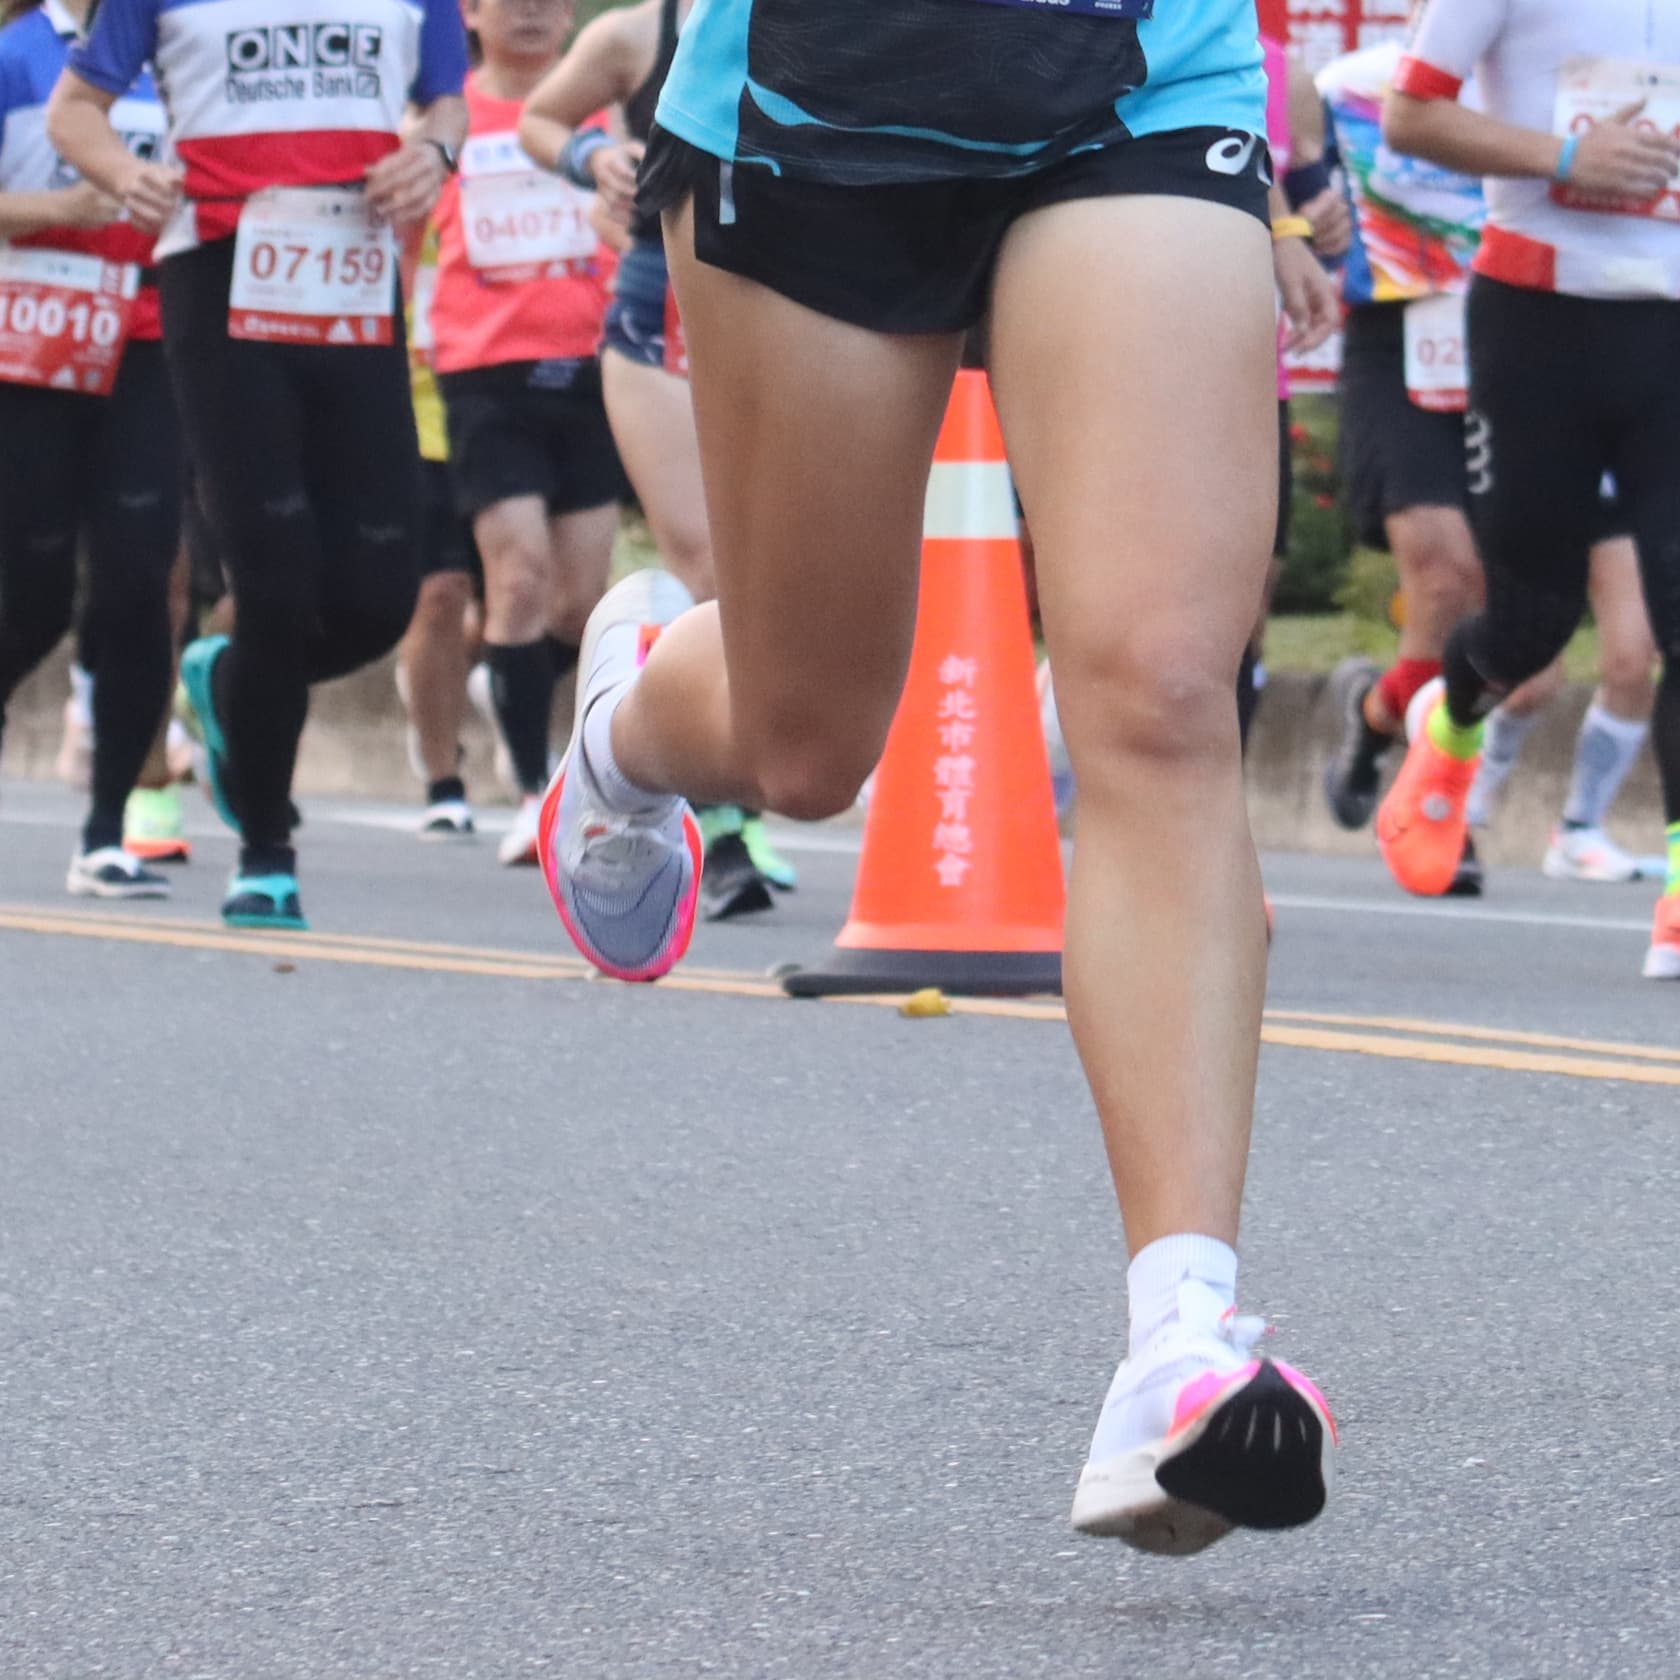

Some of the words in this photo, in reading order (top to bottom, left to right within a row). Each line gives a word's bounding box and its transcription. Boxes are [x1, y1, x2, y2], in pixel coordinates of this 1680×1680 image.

[227, 24, 380, 70] ONCE
[226, 74, 305, 103] Deutsche
[313, 71, 352, 99] Bank
[249, 242, 384, 286] 07159
